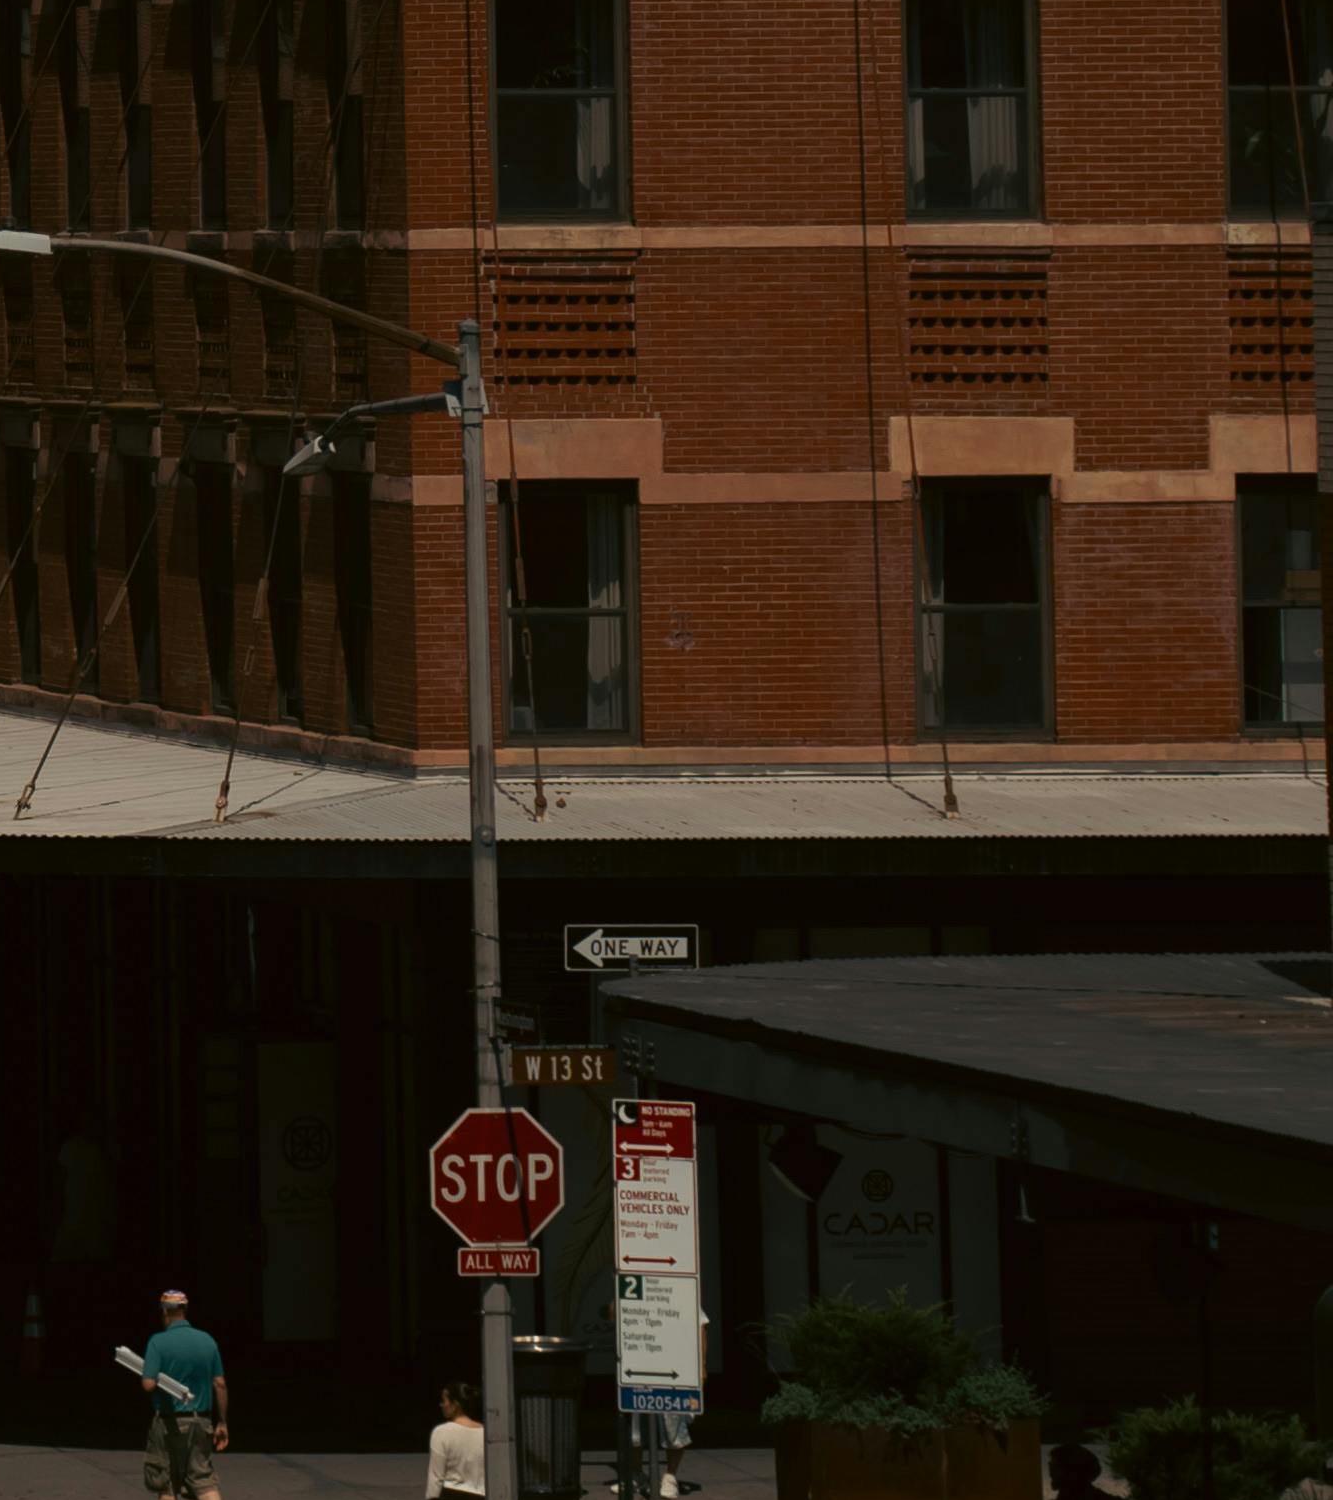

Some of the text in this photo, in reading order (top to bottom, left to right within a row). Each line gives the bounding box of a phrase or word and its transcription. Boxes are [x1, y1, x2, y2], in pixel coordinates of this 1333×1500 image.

[591, 940, 679, 956] ONE WAY
[525, 1055, 604, 1081] W 13 St
[641, 1105, 691, 1117] NO STANDING
[621, 1157, 635, 1179] 3
[440, 1152, 555, 1203] STOP
[619, 1189, 679, 1202] COMMERCIAL
[620, 1203, 690, 1216] VEHICLES ONLY
[465, 1253, 532, 1270] ALL WAY
[624, 1275, 638, 1298] 2
[622, 1306, 649, 1317] Monday
[657, 1308, 680, 1319] Friday
[622, 1331, 655, 1342] Saturday
[633, 1395, 680, 1411] 102054
